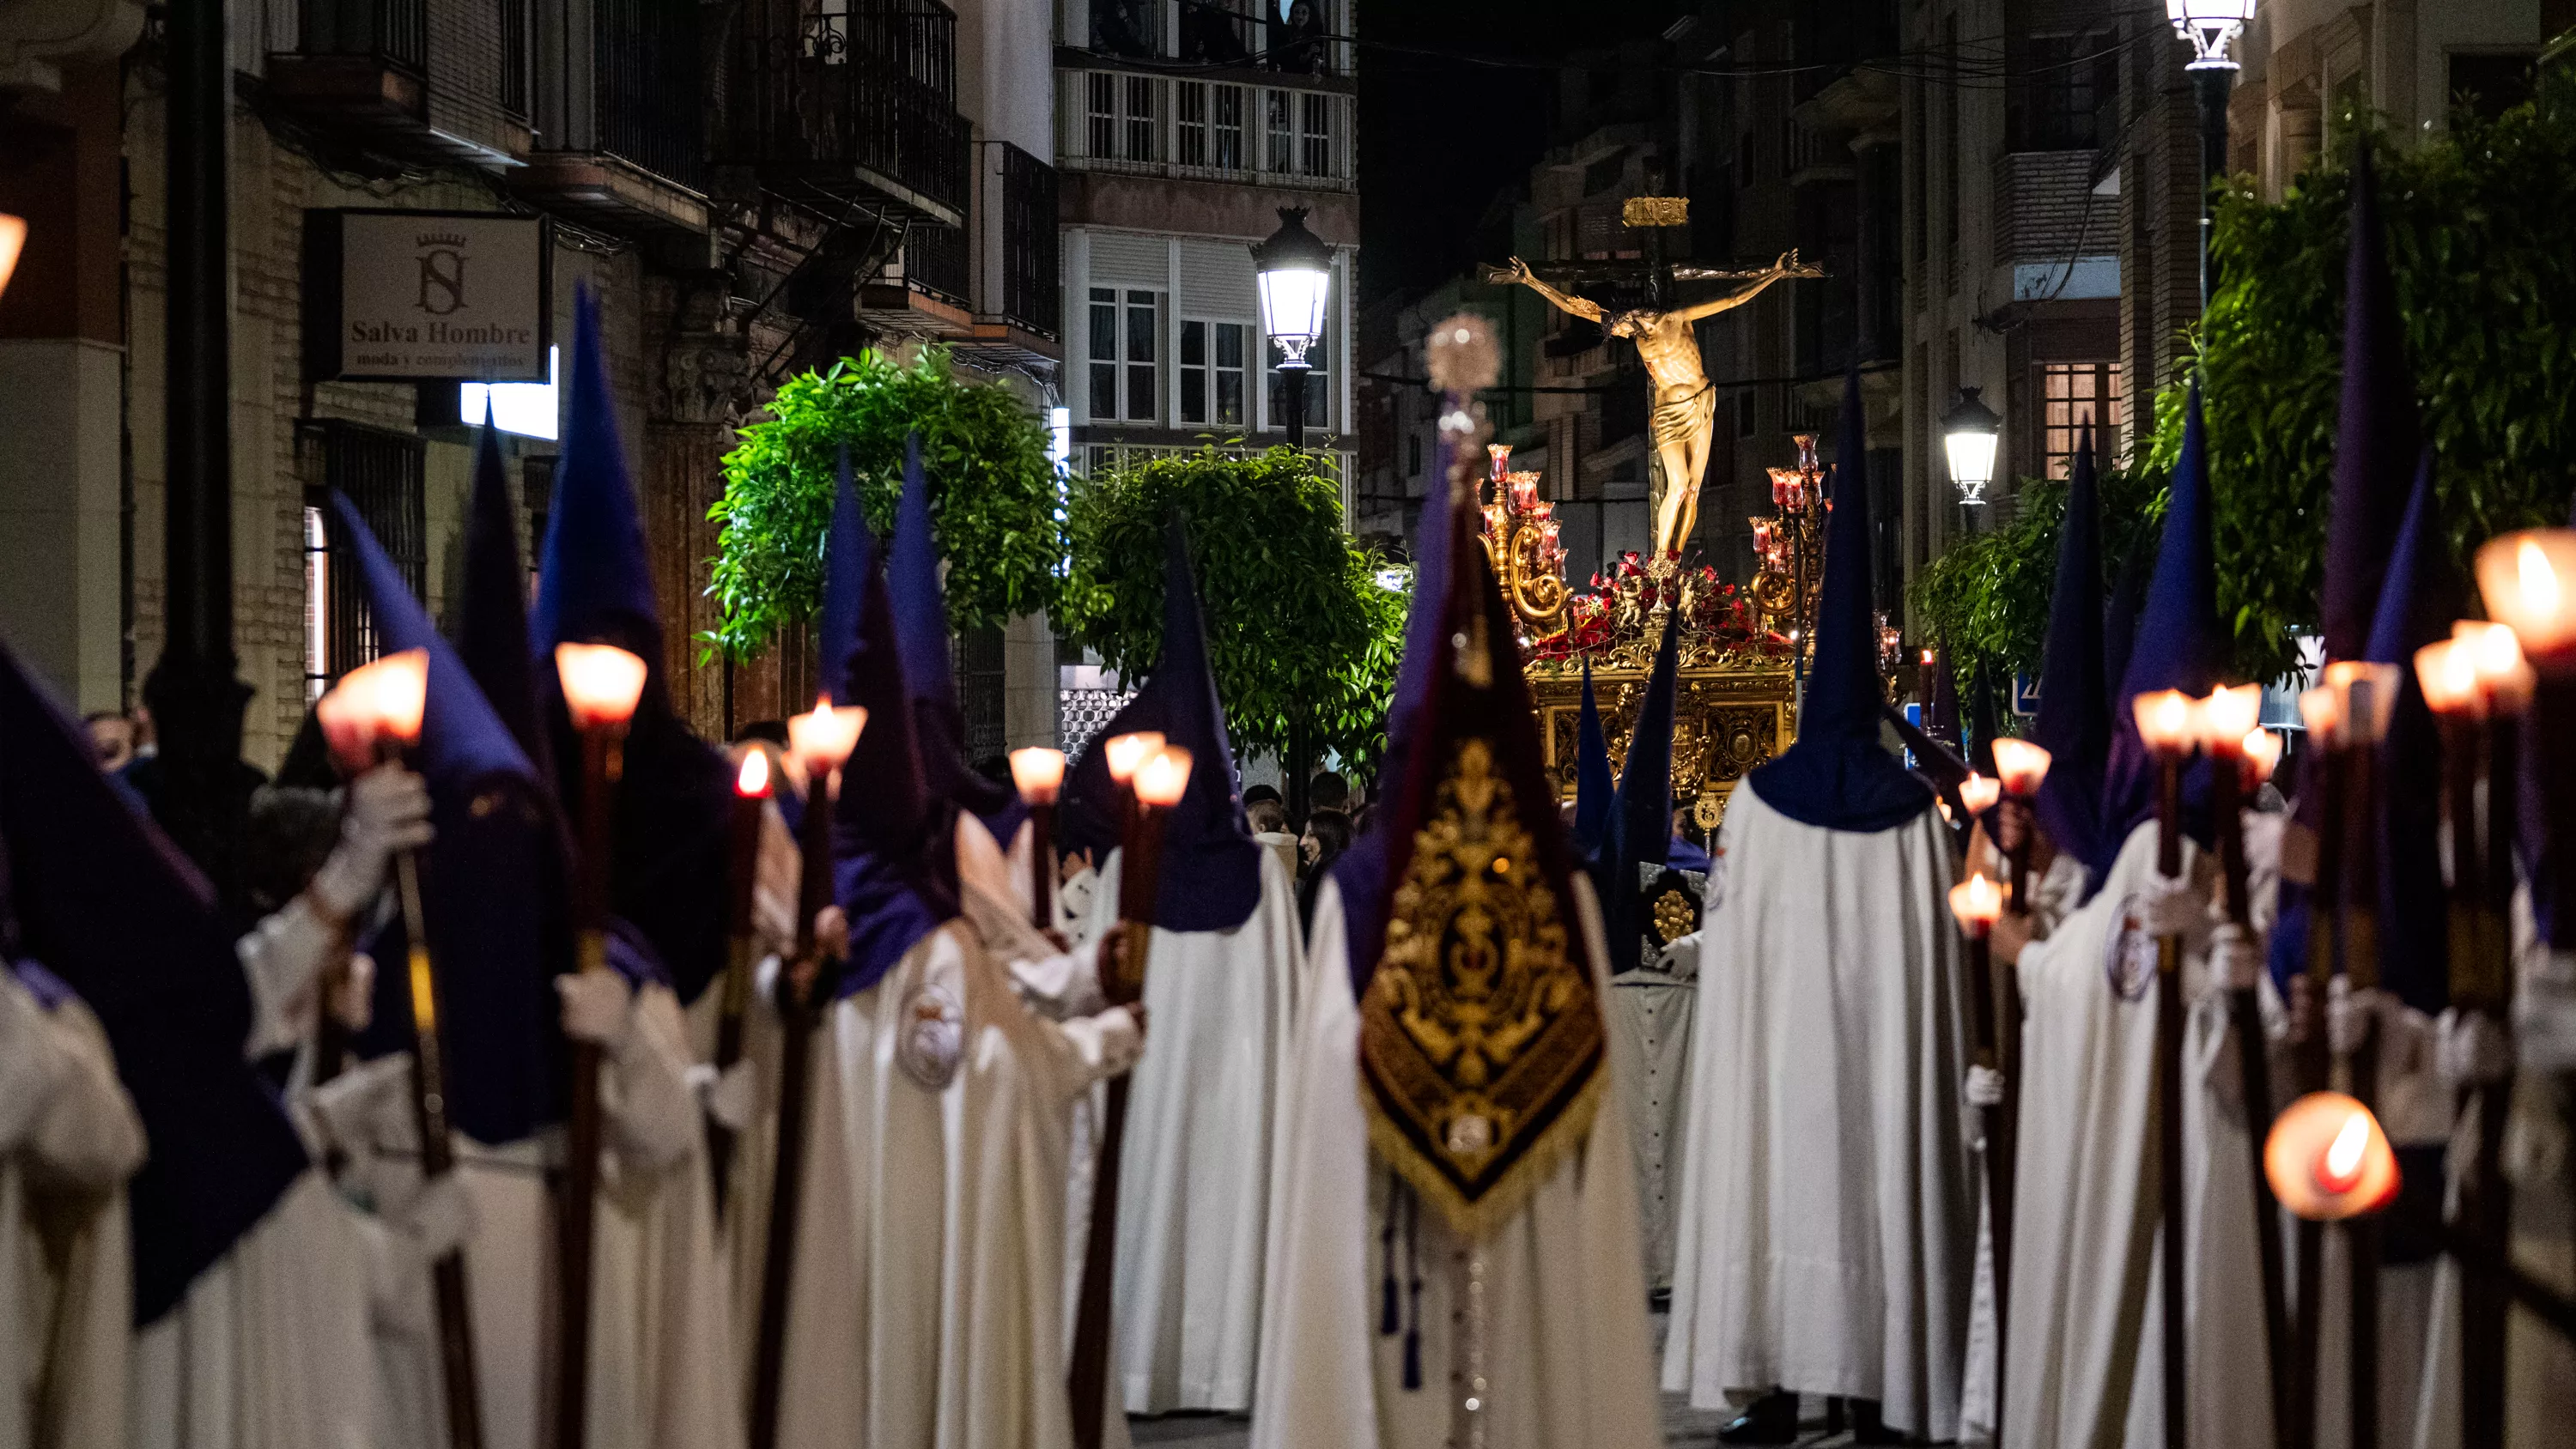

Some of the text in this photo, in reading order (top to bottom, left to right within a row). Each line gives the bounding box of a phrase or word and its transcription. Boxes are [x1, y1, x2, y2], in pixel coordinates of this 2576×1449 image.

[350, 320, 532, 344] Salva Hombre
[357, 352, 399, 367] moda
[416, 353, 524, 369] complementos
